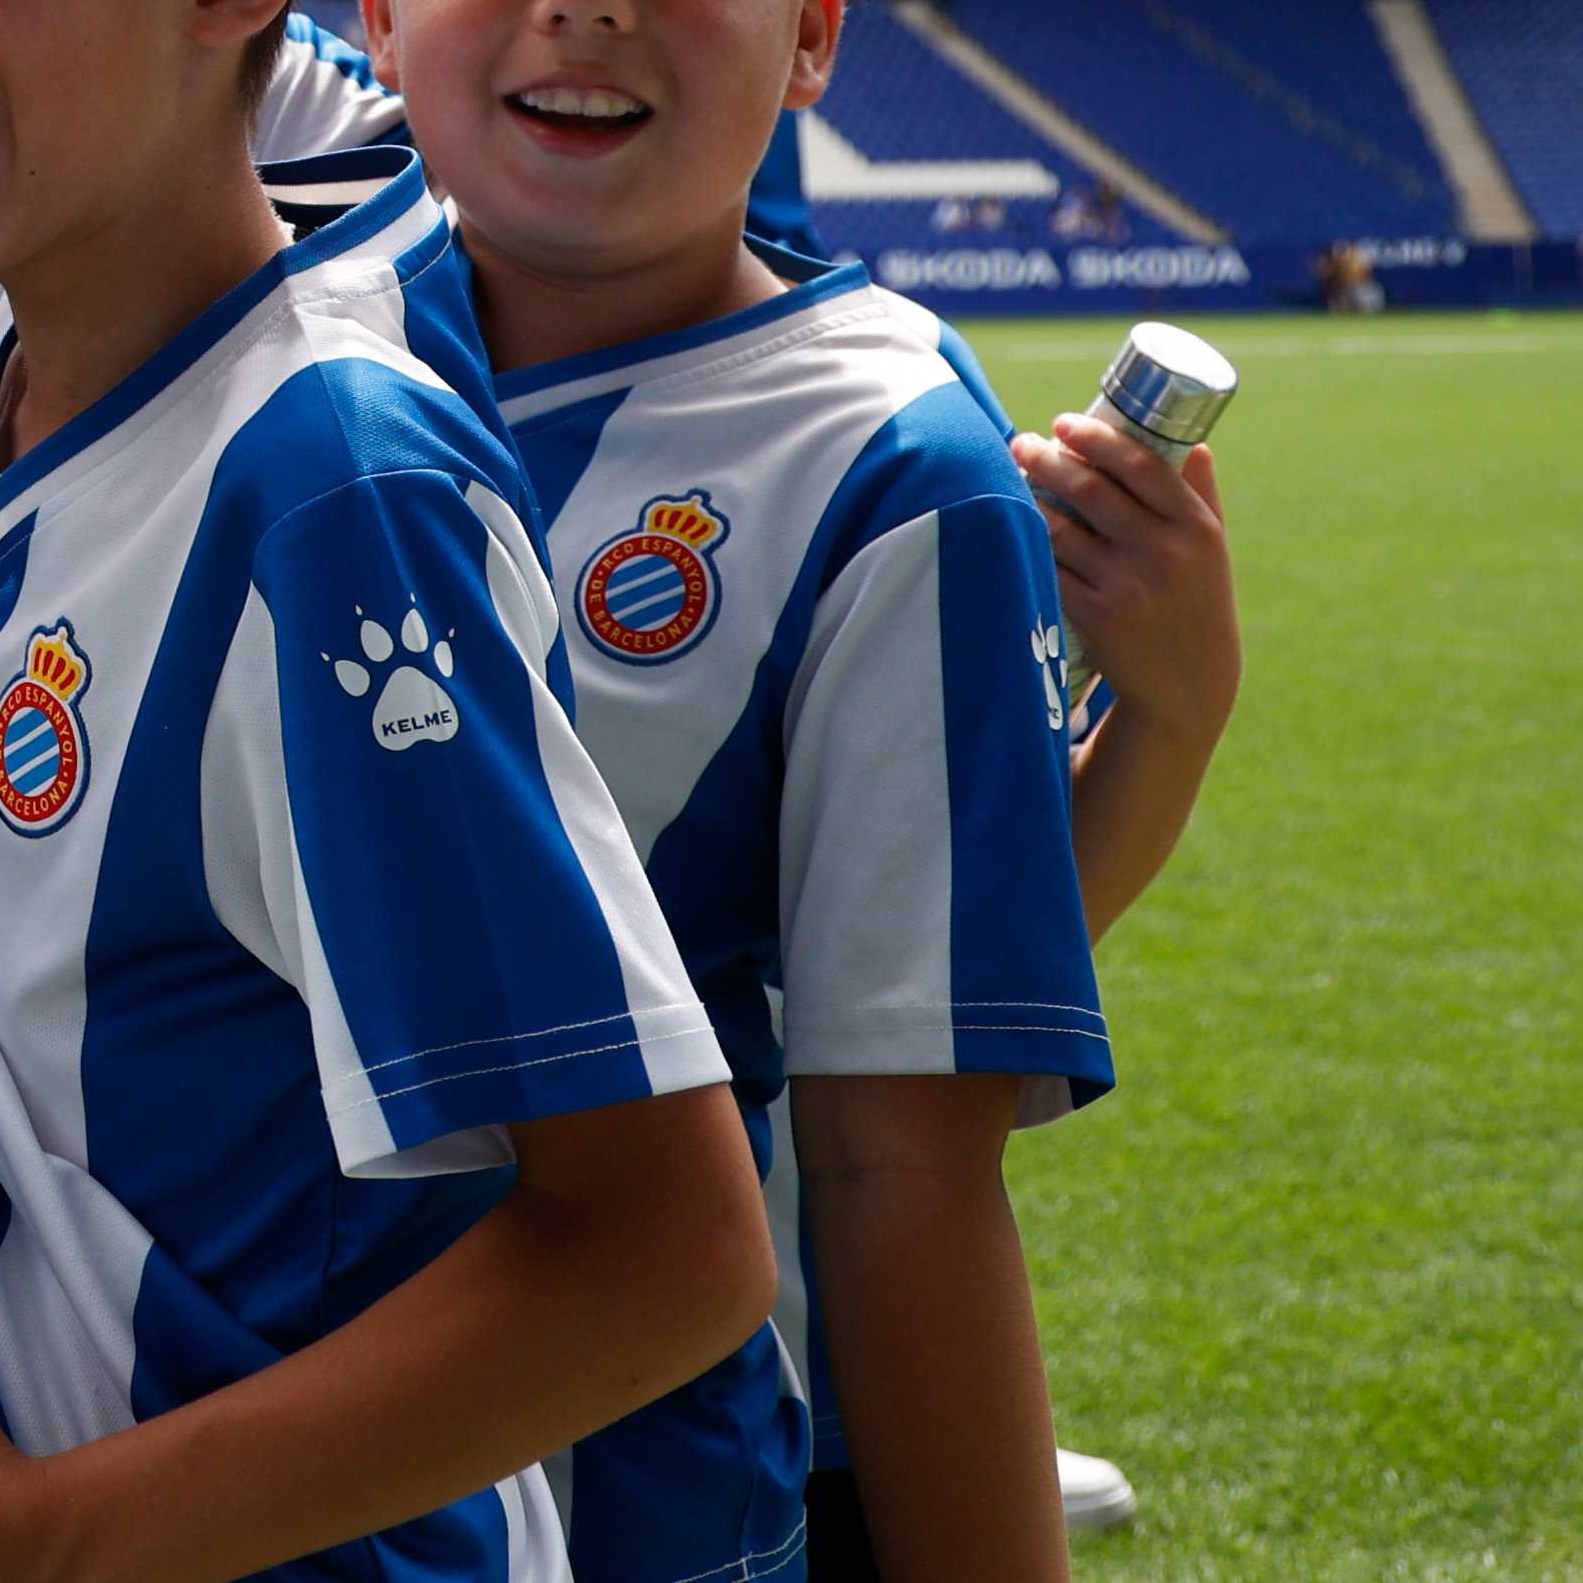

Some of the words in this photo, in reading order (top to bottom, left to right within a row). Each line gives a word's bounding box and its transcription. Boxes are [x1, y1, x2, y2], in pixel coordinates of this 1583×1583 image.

[602, 542, 634, 568] RCD
[641, 538, 703, 604] ESPANYOL
[589, 579, 603, 604] DE
[593, 609, 694, 649] BARCELONA
[1, 689, 22, 721] RCD
[25, 686, 73, 765] ESPANYOL
[381, 709, 453, 737] KELME
